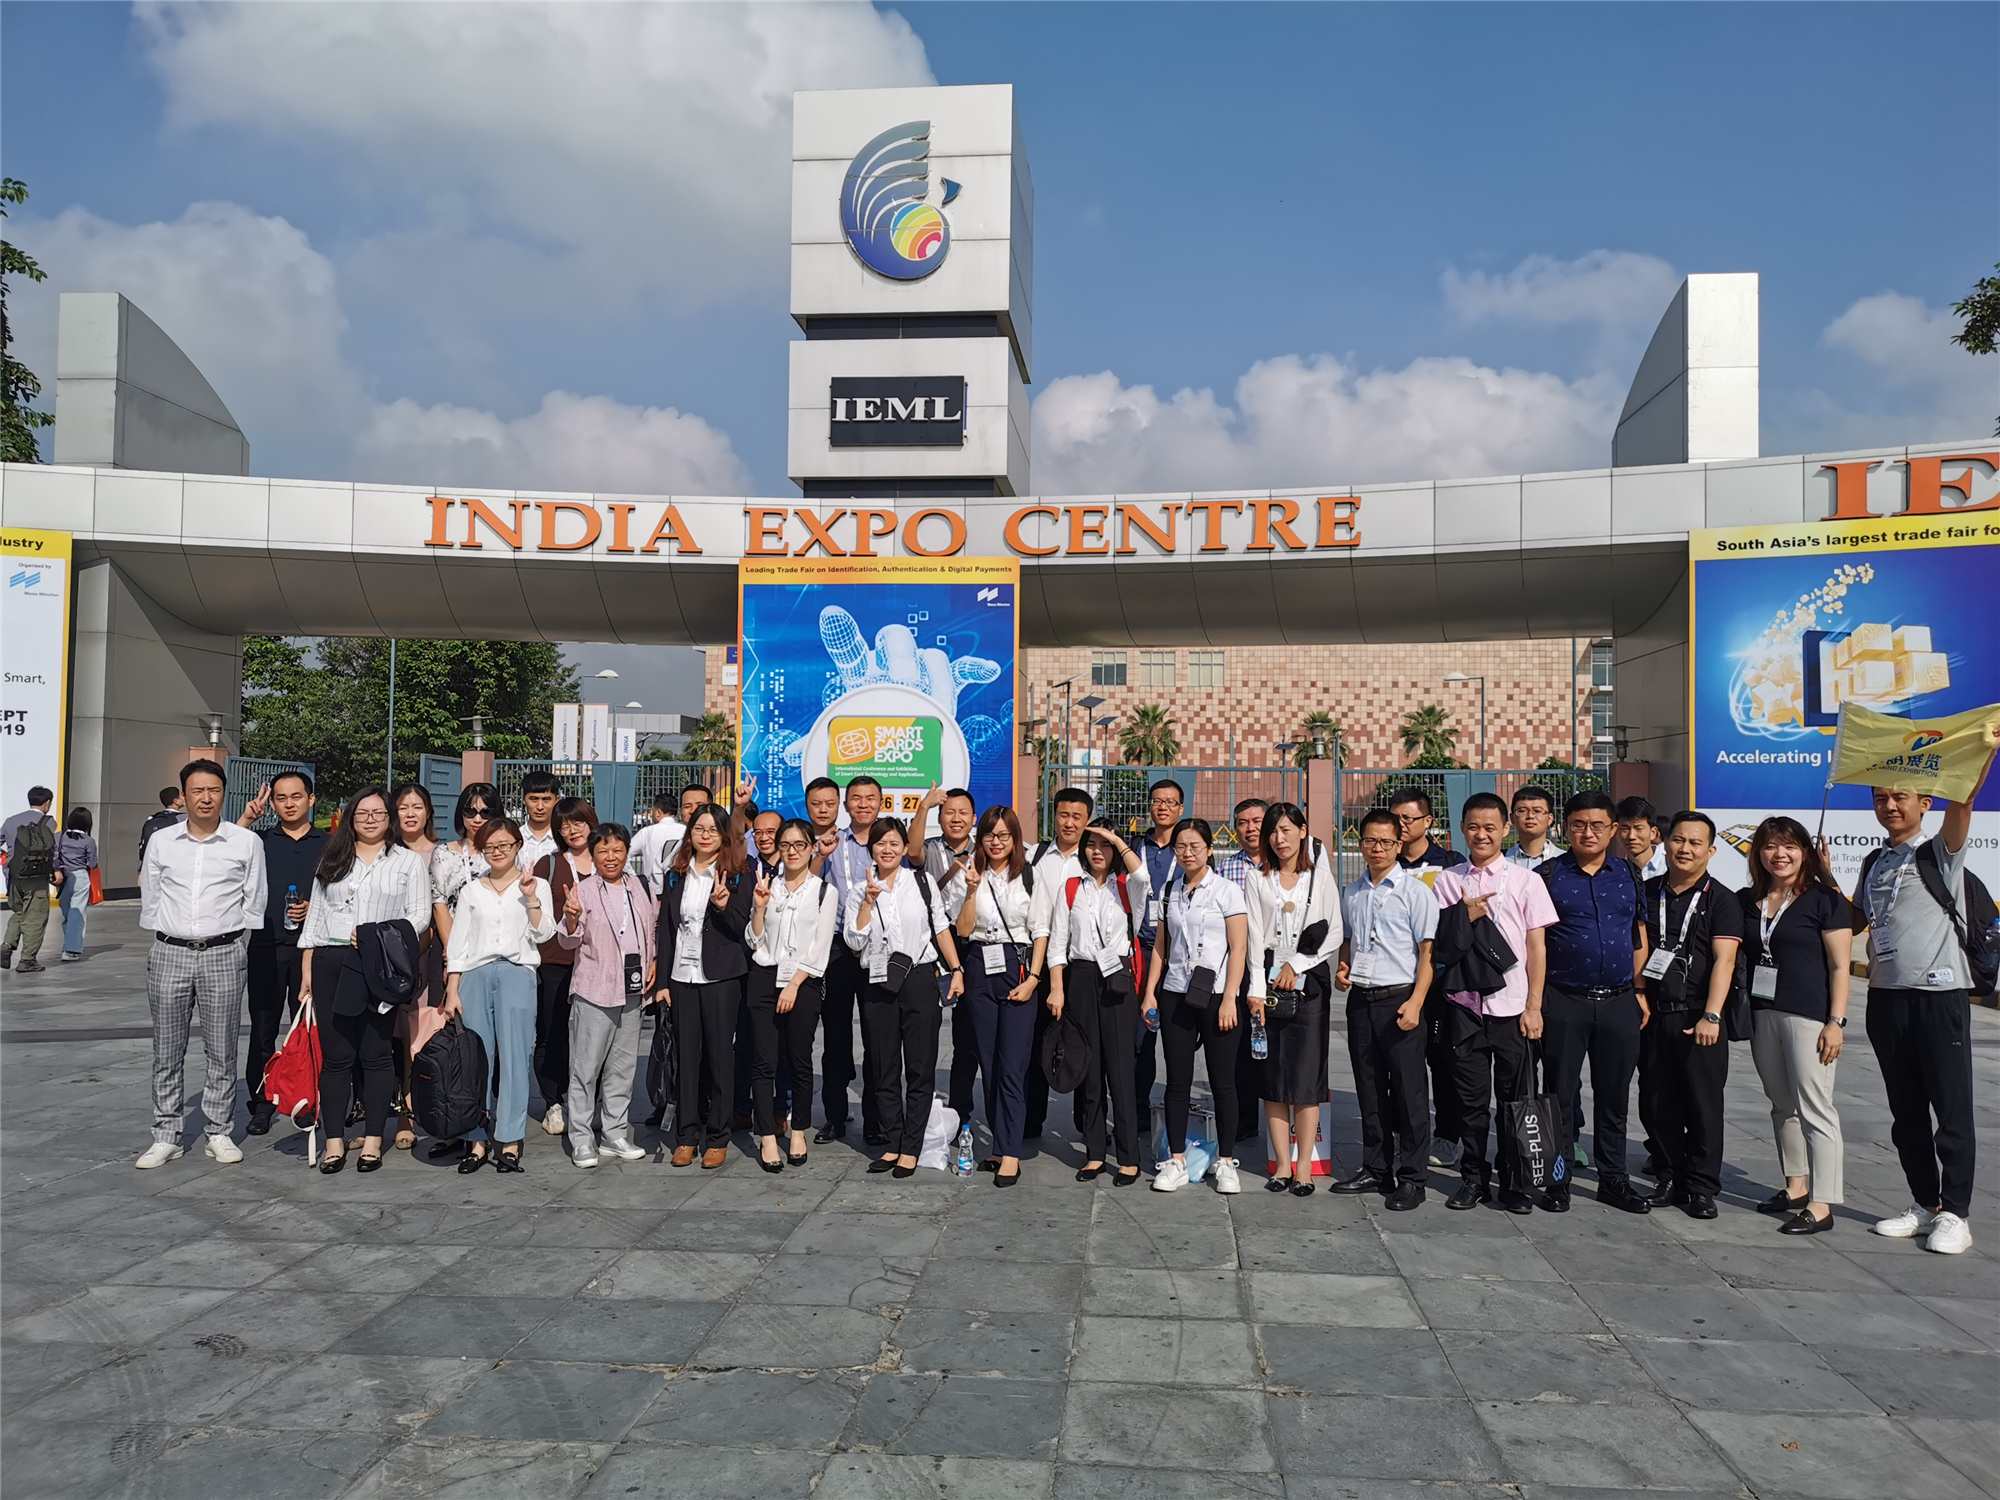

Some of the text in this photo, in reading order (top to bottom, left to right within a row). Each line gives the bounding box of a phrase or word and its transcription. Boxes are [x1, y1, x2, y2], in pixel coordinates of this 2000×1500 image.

[832, 396, 962, 422] IEML
[424, 495, 1363, 557] INDIA EXPO CENTRE
[0, 536, 44, 550] ustry
[1717, 539, 1764, 551] South
[1770, 536, 1820, 549] Asia's
[1826, 531, 1888, 546] largest
[1894, 528, 1941, 541] trade
[1947, 526, 1978, 538] fair
[745, 566, 775, 575] Leading
[828, 565, 880, 574] Identification,
[882, 565, 938, 573] Authentication
[948, 566, 973, 574] Digital
[975, 566, 1012, 574] Payments
[4, 672, 46, 686] Smart,
[875, 726, 924, 739] SMART
[875, 739, 925, 751] CARDS
[875, 750, 914, 763] EXPO
[1716, 749, 1821, 767] Accelerating
[903, 796, 919, 810] 27
[1968, 837, 1999, 849] 2019
[1525, 1114, 1544, 1186] SEE-PLUS
